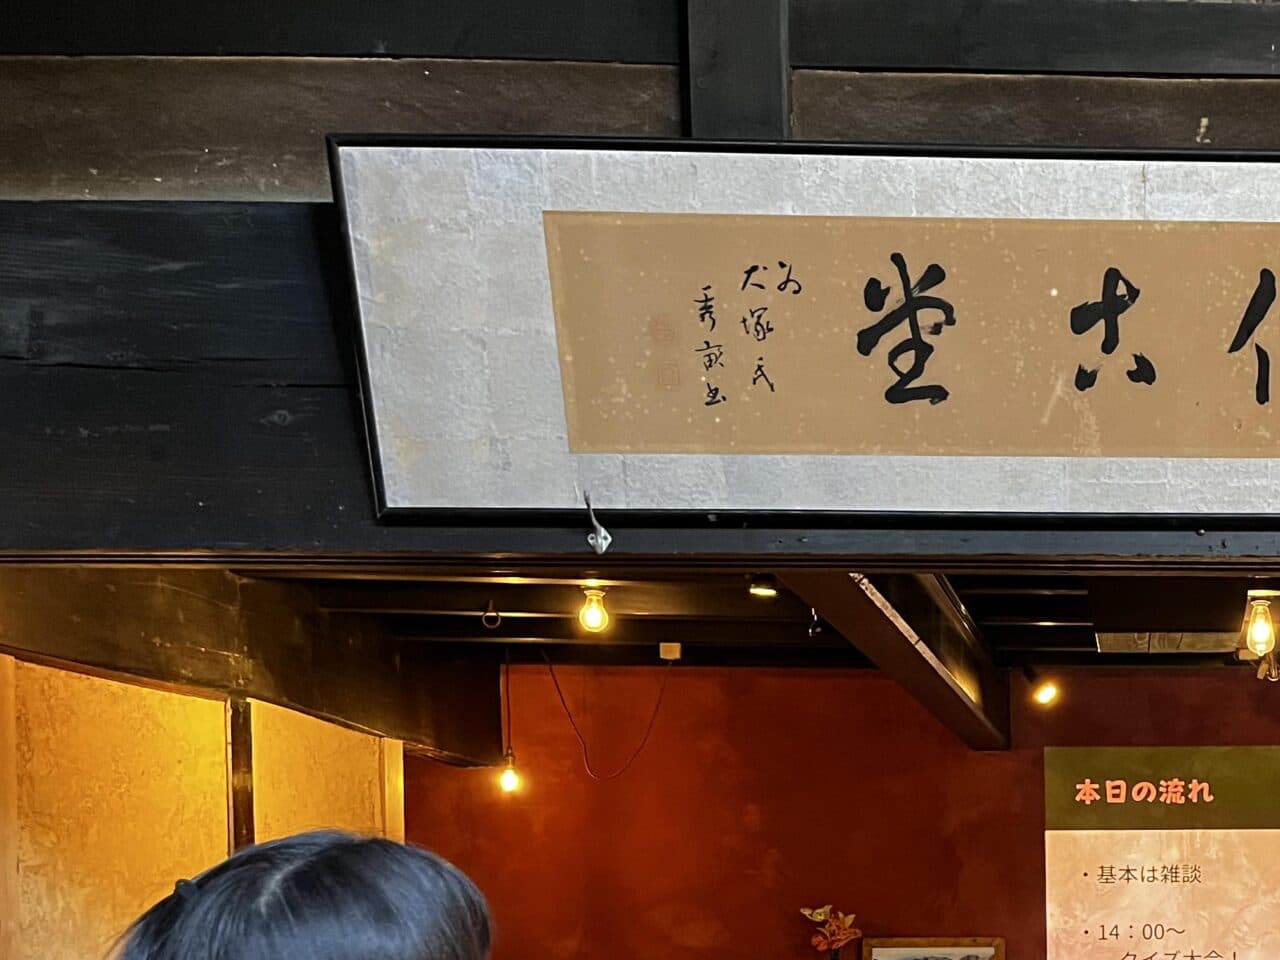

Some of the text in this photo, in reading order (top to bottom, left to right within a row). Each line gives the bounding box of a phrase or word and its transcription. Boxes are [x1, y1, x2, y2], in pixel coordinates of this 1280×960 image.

[1075, 778, 1214, 804] 本日の流れ
